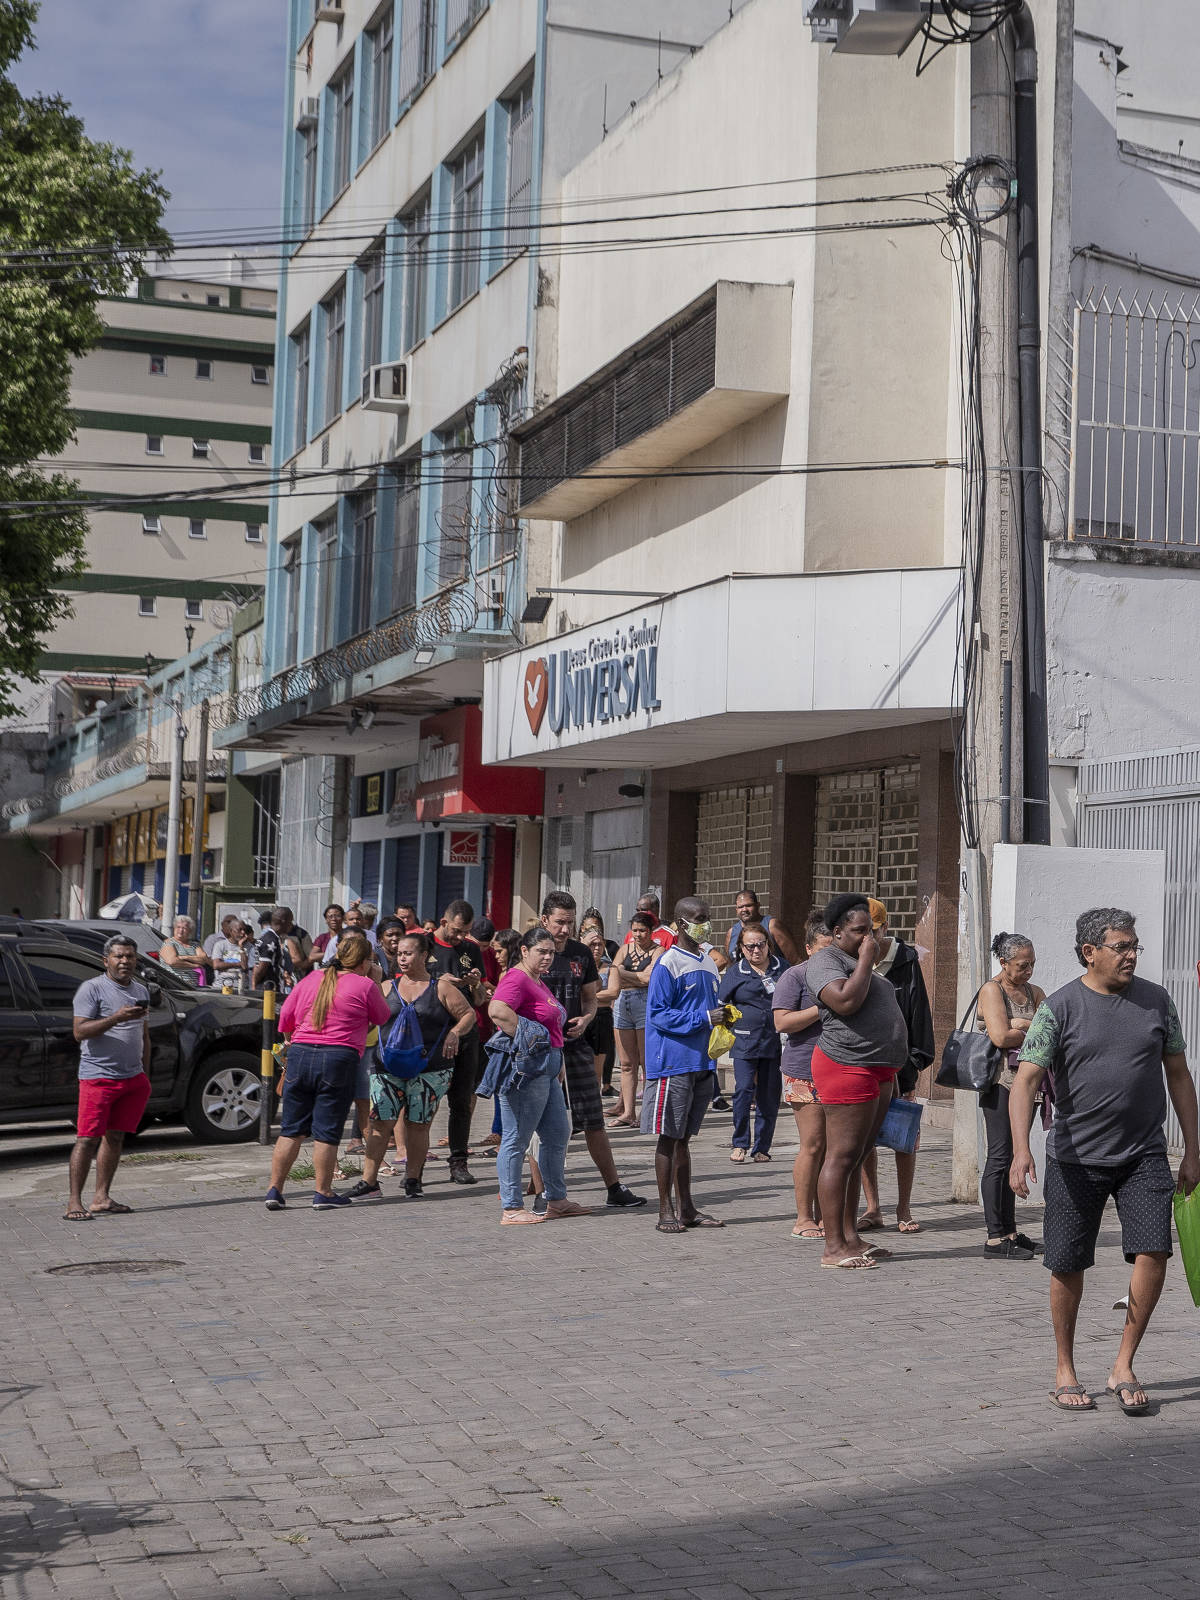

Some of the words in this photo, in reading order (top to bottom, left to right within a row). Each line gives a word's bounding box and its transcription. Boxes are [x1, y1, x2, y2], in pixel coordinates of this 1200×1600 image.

[568, 647, 588, 673] Jesus
[588, 636, 613, 663] Cristo
[628, 617, 658, 649] Senhor
[547, 645, 662, 735] UNIVERSAL
[449, 855, 479, 865] DINIZ
